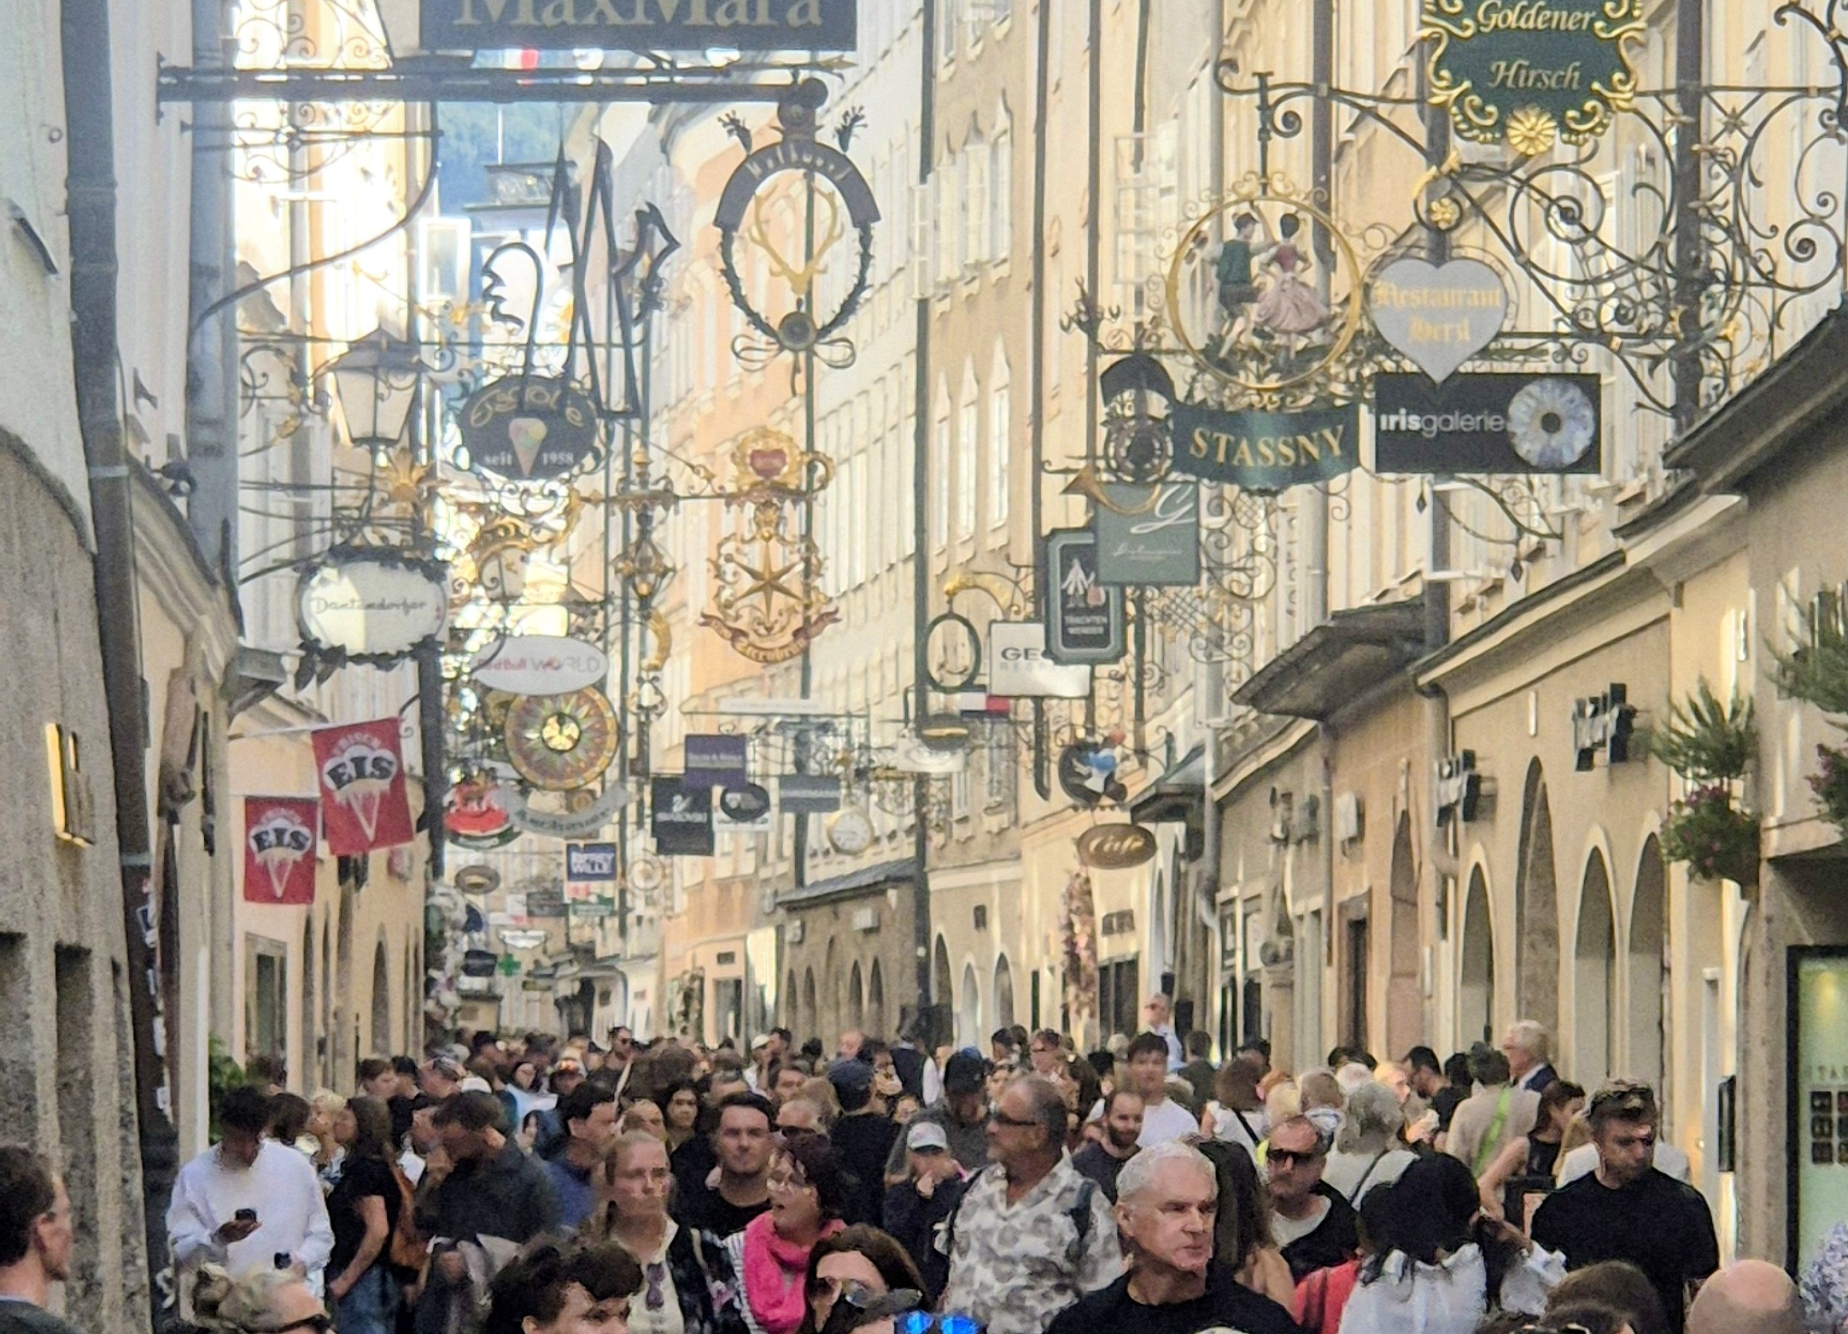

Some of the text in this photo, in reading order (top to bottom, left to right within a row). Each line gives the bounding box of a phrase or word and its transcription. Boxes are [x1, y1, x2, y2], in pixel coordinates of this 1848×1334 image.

[1478, 0, 1598, 32] Goldener
[1487, 61, 1581, 90] Hirsch
[1374, 281, 1501, 309] Restaurant
[484, 451, 513, 467] seit
[1190, 425, 1345, 468] STASSNY
[1000, 647, 1040, 661] GE
[327, 756, 394, 790] EIS
[252, 827, 310, 853] EIS
